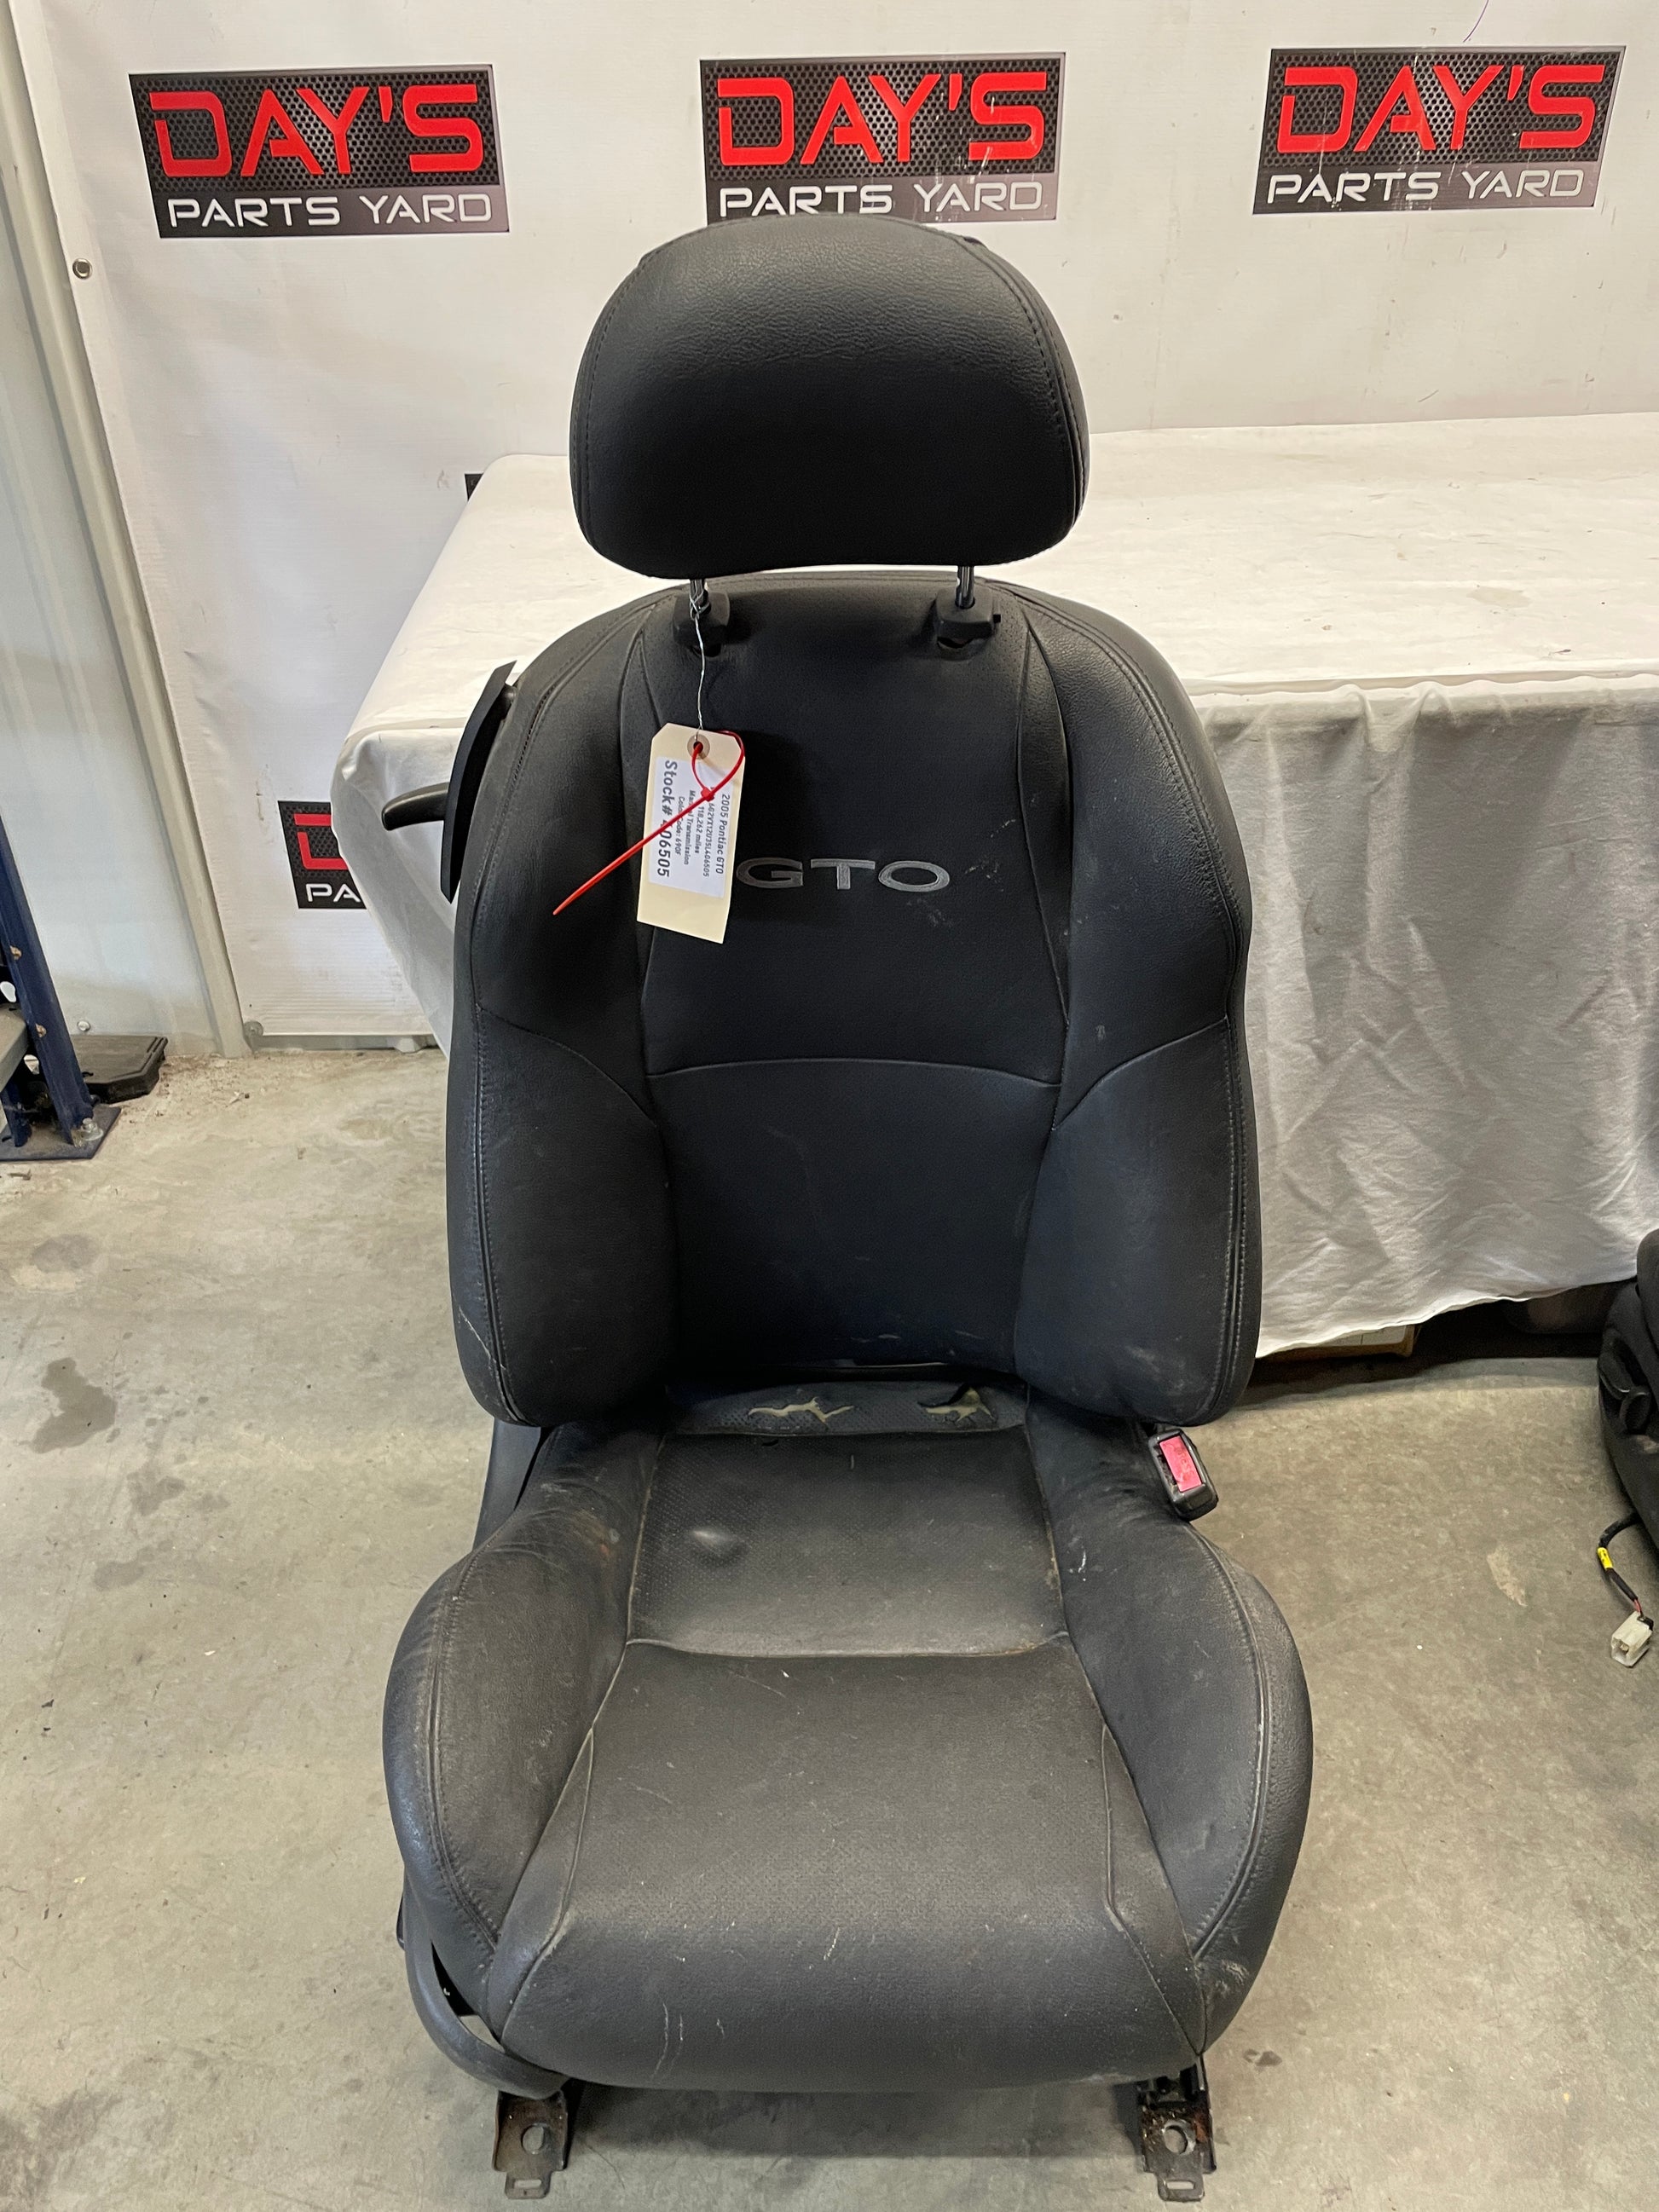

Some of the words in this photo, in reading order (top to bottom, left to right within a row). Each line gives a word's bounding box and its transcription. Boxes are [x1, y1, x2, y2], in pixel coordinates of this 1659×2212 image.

[718, 72, 1047, 165] DAY'S
[1277, 64, 1605, 153] DAY'S
[149, 84, 483, 177] DAY'S
[720, 184, 893, 217] PARTS
[913, 182, 1043, 212] YARD
[1267, 171, 1441, 204] PARTS
[1461, 169, 1584, 199] YARD
[168, 196, 340, 228] PARTS
[359, 193, 491, 224] YARD
[662, 760, 678, 816] Stock#
[720, 794, 731, 818] 2005
[684, 817, 694, 866] Transmission
[717, 820, 728, 855] Pontiac
[736, 857, 950, 892] GTO
